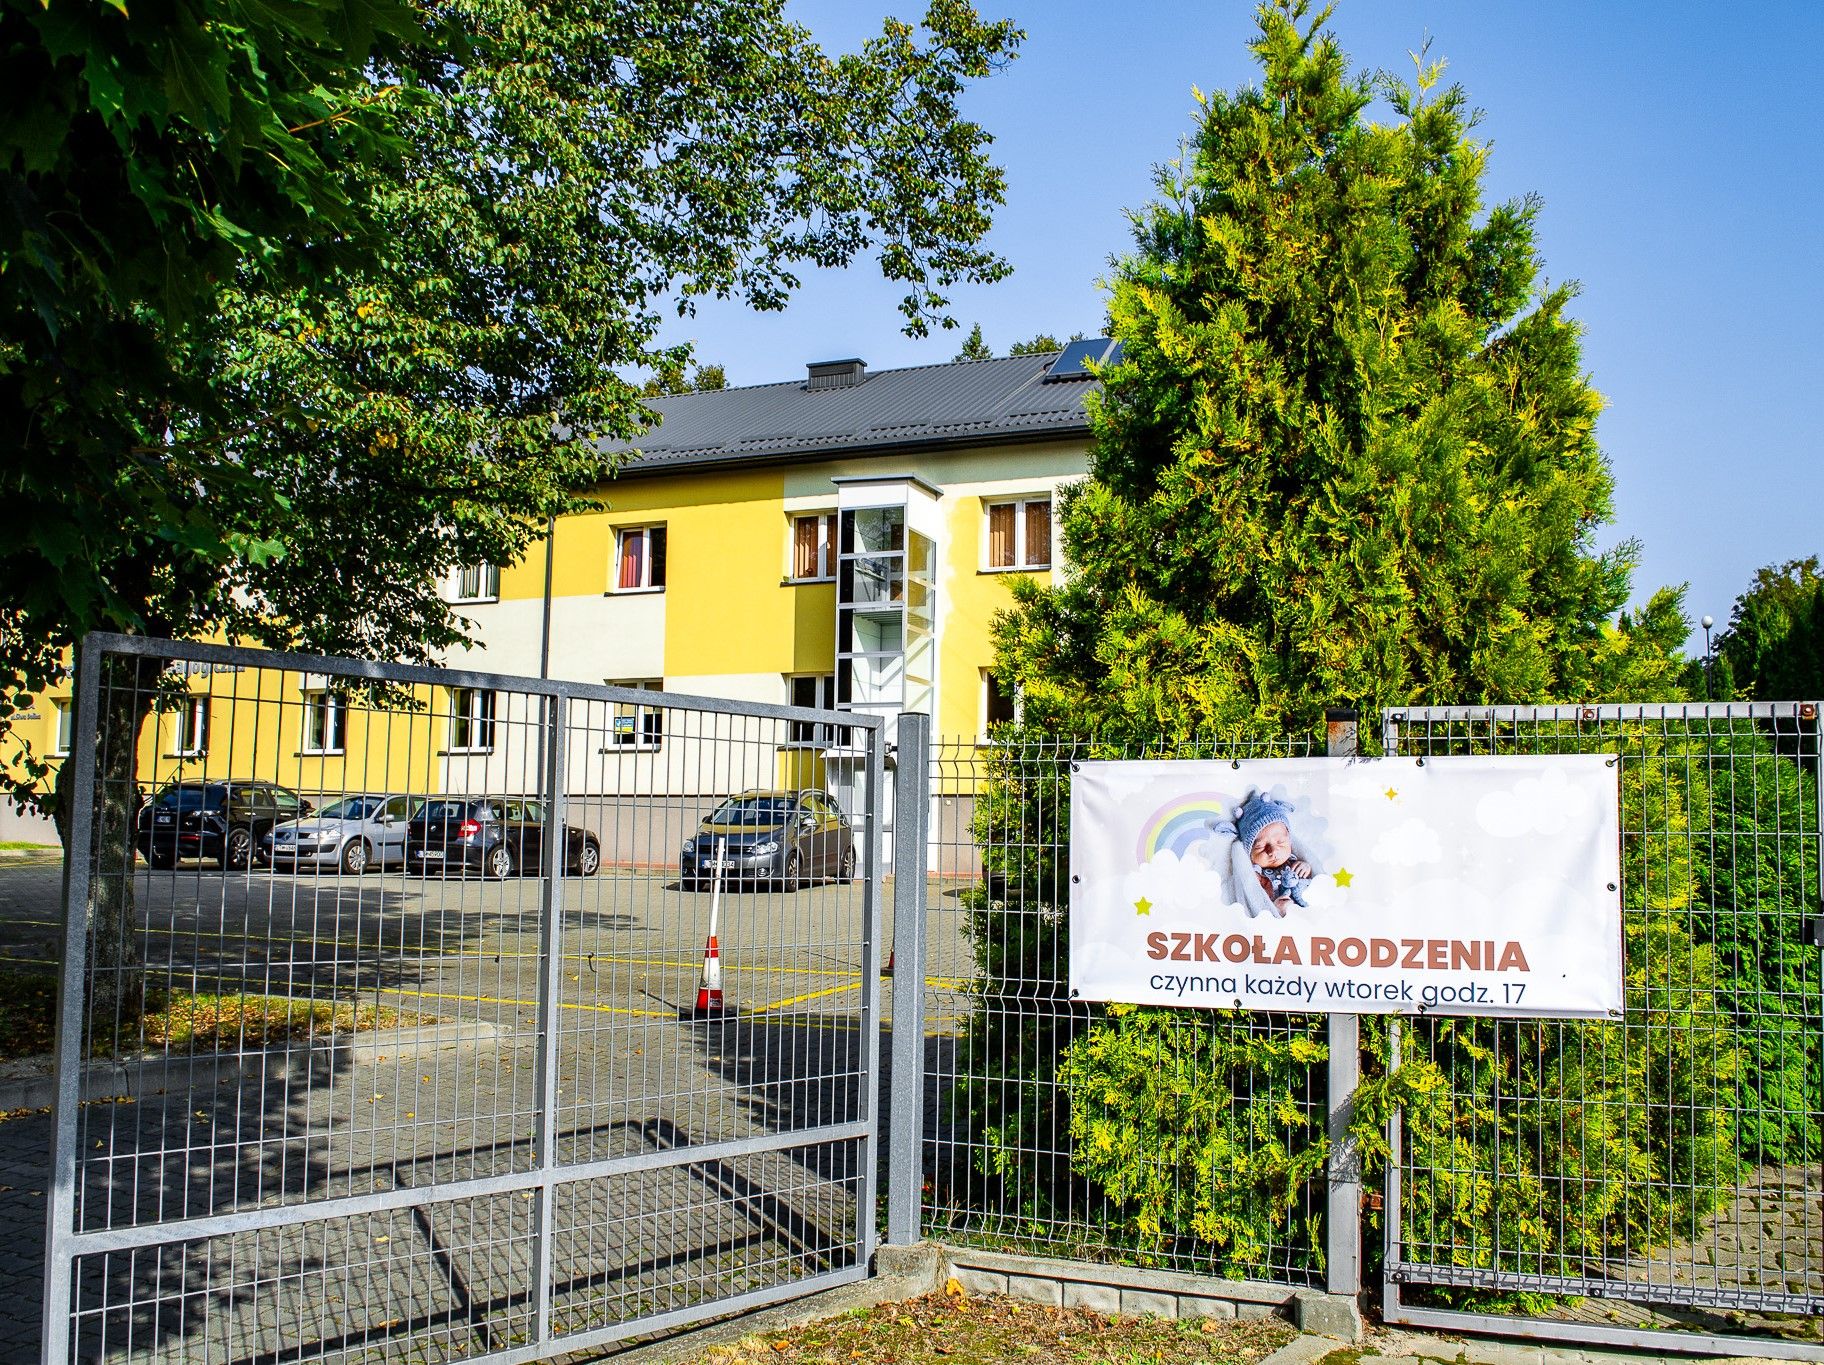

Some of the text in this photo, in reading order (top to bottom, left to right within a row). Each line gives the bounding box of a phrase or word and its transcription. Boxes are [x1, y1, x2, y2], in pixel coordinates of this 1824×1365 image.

[1146, 931, 1531, 972] SZKOŁA RODZENIA
[1149, 973, 1527, 1008] czynna każdy wtorek godz. 17
